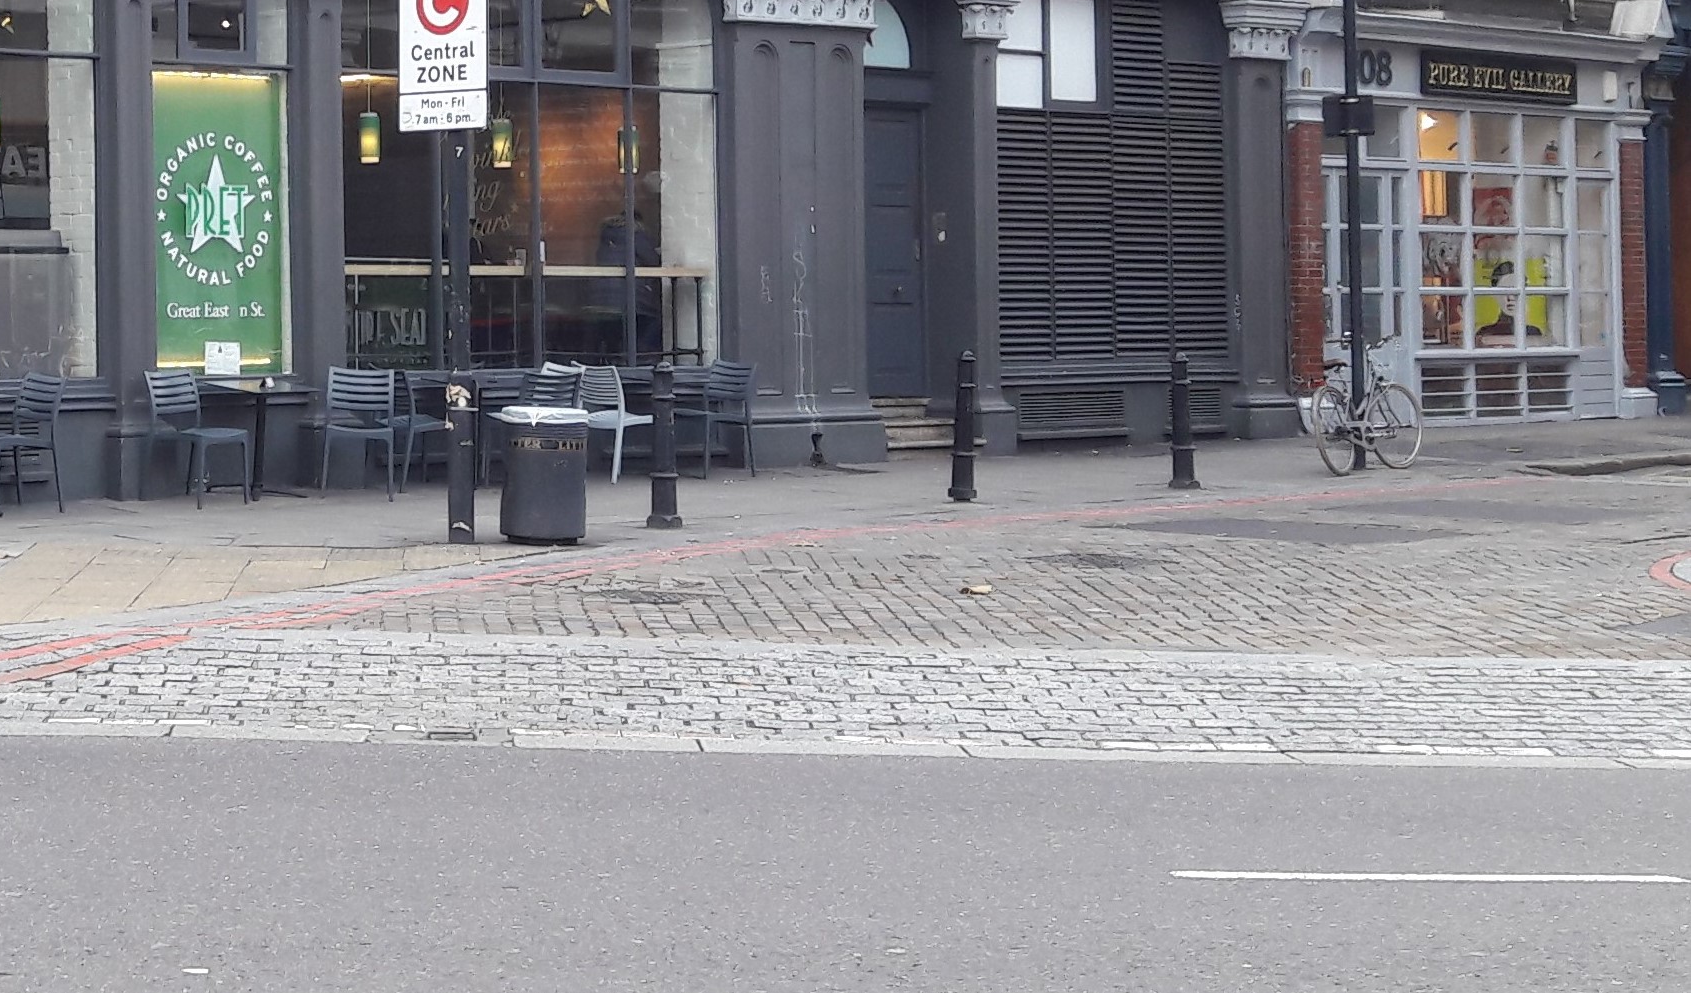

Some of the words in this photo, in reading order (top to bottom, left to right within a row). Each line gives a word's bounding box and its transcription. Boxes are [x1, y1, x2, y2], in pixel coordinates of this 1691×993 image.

[411, 40, 476, 62] Central
[416, 63, 468, 84] ZONE
[1358, 48, 1393, 87] 08
[1428, 61, 1469, 88] PURE
[1472, 66, 1507, 90] EVIL
[1509, 69, 1572, 95] GALLERY
[421, 98, 443, 109] Mon
[451, 96, 465, 108] Fri
[455, 146, 464, 158] 7
[156, 131, 217, 202] ORGANIC
[223, 134, 273, 202] COFFEE
[184, 182, 249, 239] PRET
[160, 230, 232, 286] NATURAL
[235, 228, 270, 279] FOOD
[166, 302, 202, 319] Great
